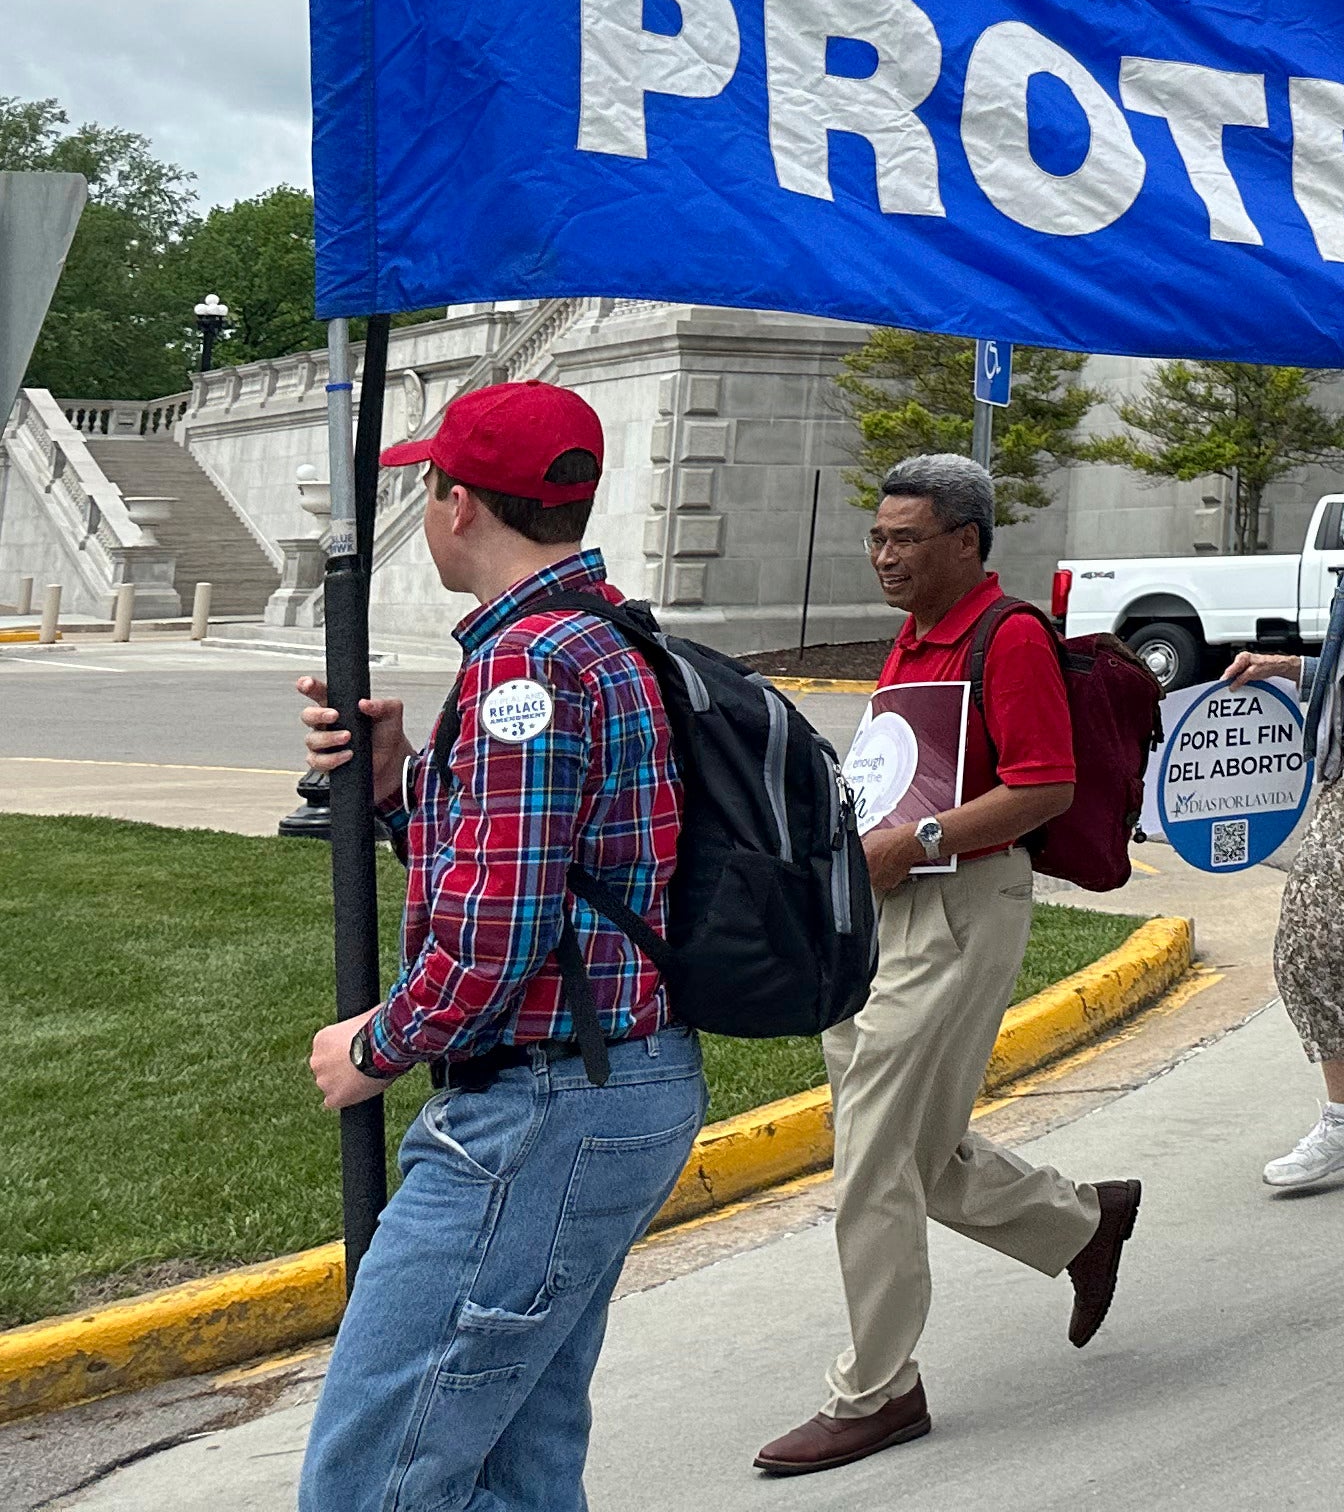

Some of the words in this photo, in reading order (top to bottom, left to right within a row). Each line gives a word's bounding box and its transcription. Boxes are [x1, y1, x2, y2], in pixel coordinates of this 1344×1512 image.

[489, 700, 546, 718] REPLACE
[1207, 696, 1263, 719] REZA
[490, 712, 547, 725] AMENDMENT
[1180, 730, 1219, 752] POR
[1225, 728, 1251, 747] EL
[1258, 723, 1293, 745] FIN
[852, 754, 885, 771] enough
[1168, 761, 1205, 783] DEL
[1210, 752, 1304, 779] ABORTO
